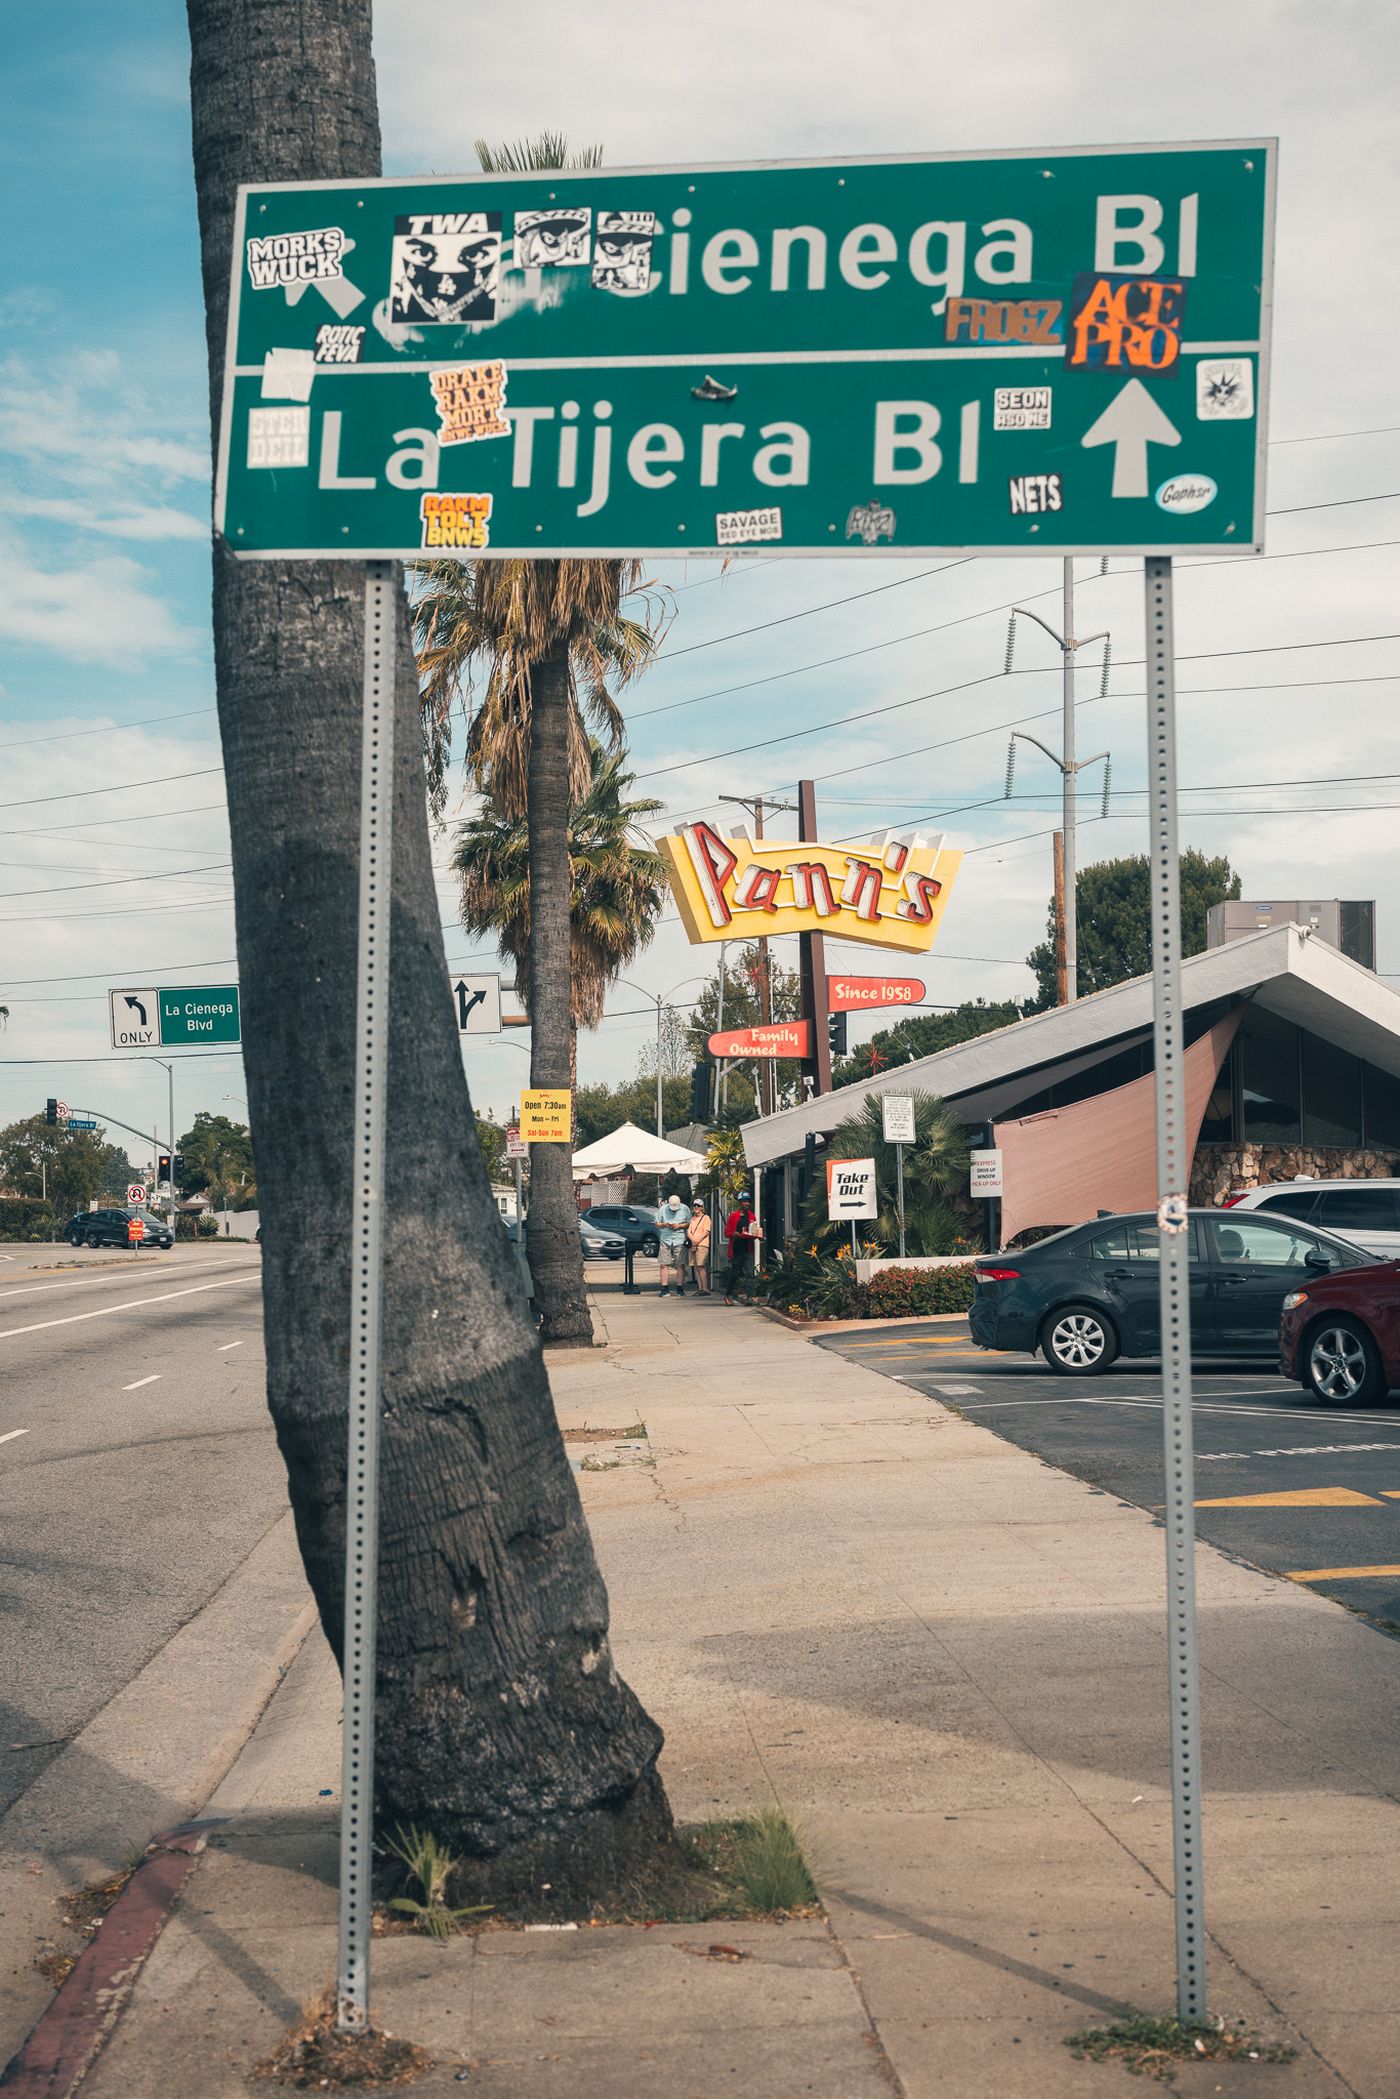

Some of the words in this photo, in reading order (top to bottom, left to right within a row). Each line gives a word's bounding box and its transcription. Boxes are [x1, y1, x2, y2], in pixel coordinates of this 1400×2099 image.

[408, 212, 489, 235] TWA
[1095, 192, 1199, 278] Bl
[250, 230, 341, 261] MORKS
[252, 251, 339, 286] WUCK
[1073, 279, 1183, 328] ACE
[1071, 322, 1179, 369] PRO
[434, 362, 503, 393] DRAKE
[438, 382, 502, 412] RAKM
[998, 390, 1048, 409] SEON
[445, 402, 500, 431] MORT
[318, 410, 440, 491] La
[503, 400, 811, 517] Tijera
[873, 400, 980, 484] Bl
[424, 496, 489, 511] RAKM
[1010, 475, 1062, 514] NETS
[424, 510, 488, 528] TOLT
[719, 512, 779, 529] SAVAGE
[425, 527, 487, 547] BNWS
[720, 529, 738, 539] RED
[682, 821, 942, 927] Pann's
[835, 983, 878, 999] Since
[882, 986, 912, 1001] 1958
[165, 1005, 179, 1016] La
[185, 1003, 233, 1016] Cienega
[187, 1019, 213, 1031] Blvd
[120, 1031, 152, 1043] ONLY
[751, 1029, 798, 1046] Family
[729, 1043, 777, 1055] Owned
[525, 1101, 541, 1110] Open
[544, 1101, 567, 1109] 7:30am
[836, 1173, 869, 1184] Take
[840, 1184, 864, 1195] Out
